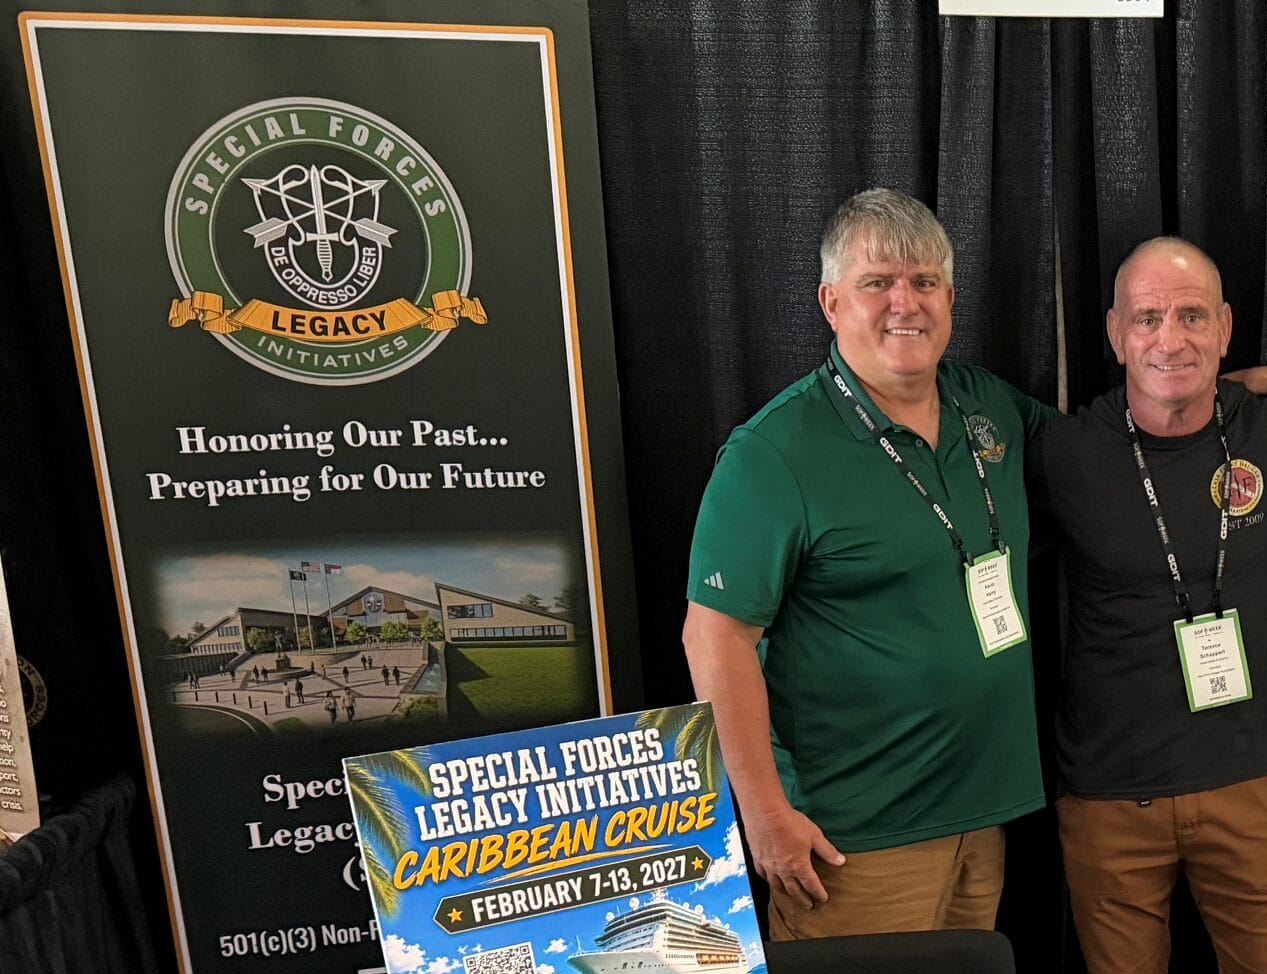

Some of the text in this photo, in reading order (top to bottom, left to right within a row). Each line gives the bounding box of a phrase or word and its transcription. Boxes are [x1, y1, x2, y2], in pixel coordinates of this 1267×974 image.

[185, 112, 446, 218] SPECIAL FORCES
[270, 245, 377, 305] DE OPPRESSO LIBER
[271, 310, 389, 337] LEGACY
[257, 335, 410, 369] INITIATIVES
[834, 374, 853, 398] GDIT
[176, 419, 508, 457] Honoring Our Past...
[880, 436, 903, 464] GDIT
[147, 463, 546, 506] Preparing for Our Future
[1143, 478, 1158, 507] GDIT
[933, 504, 954, 530] GDIT
[1168, 553, 1181, 582] GDIT
[428, 728, 664, 798] SPECIAL FORCES
[414, 758, 702, 841] LEGACY INITIATIVES
[245, 821, 362, 854] Legac
[393, 814, 598, 891] CARIBBEAN
[603, 792, 718, 847] CRUISE
[471, 854, 687, 923] FEBRUARY 7-13, 2027
[220, 926, 317, 958] 501(c)(3)
